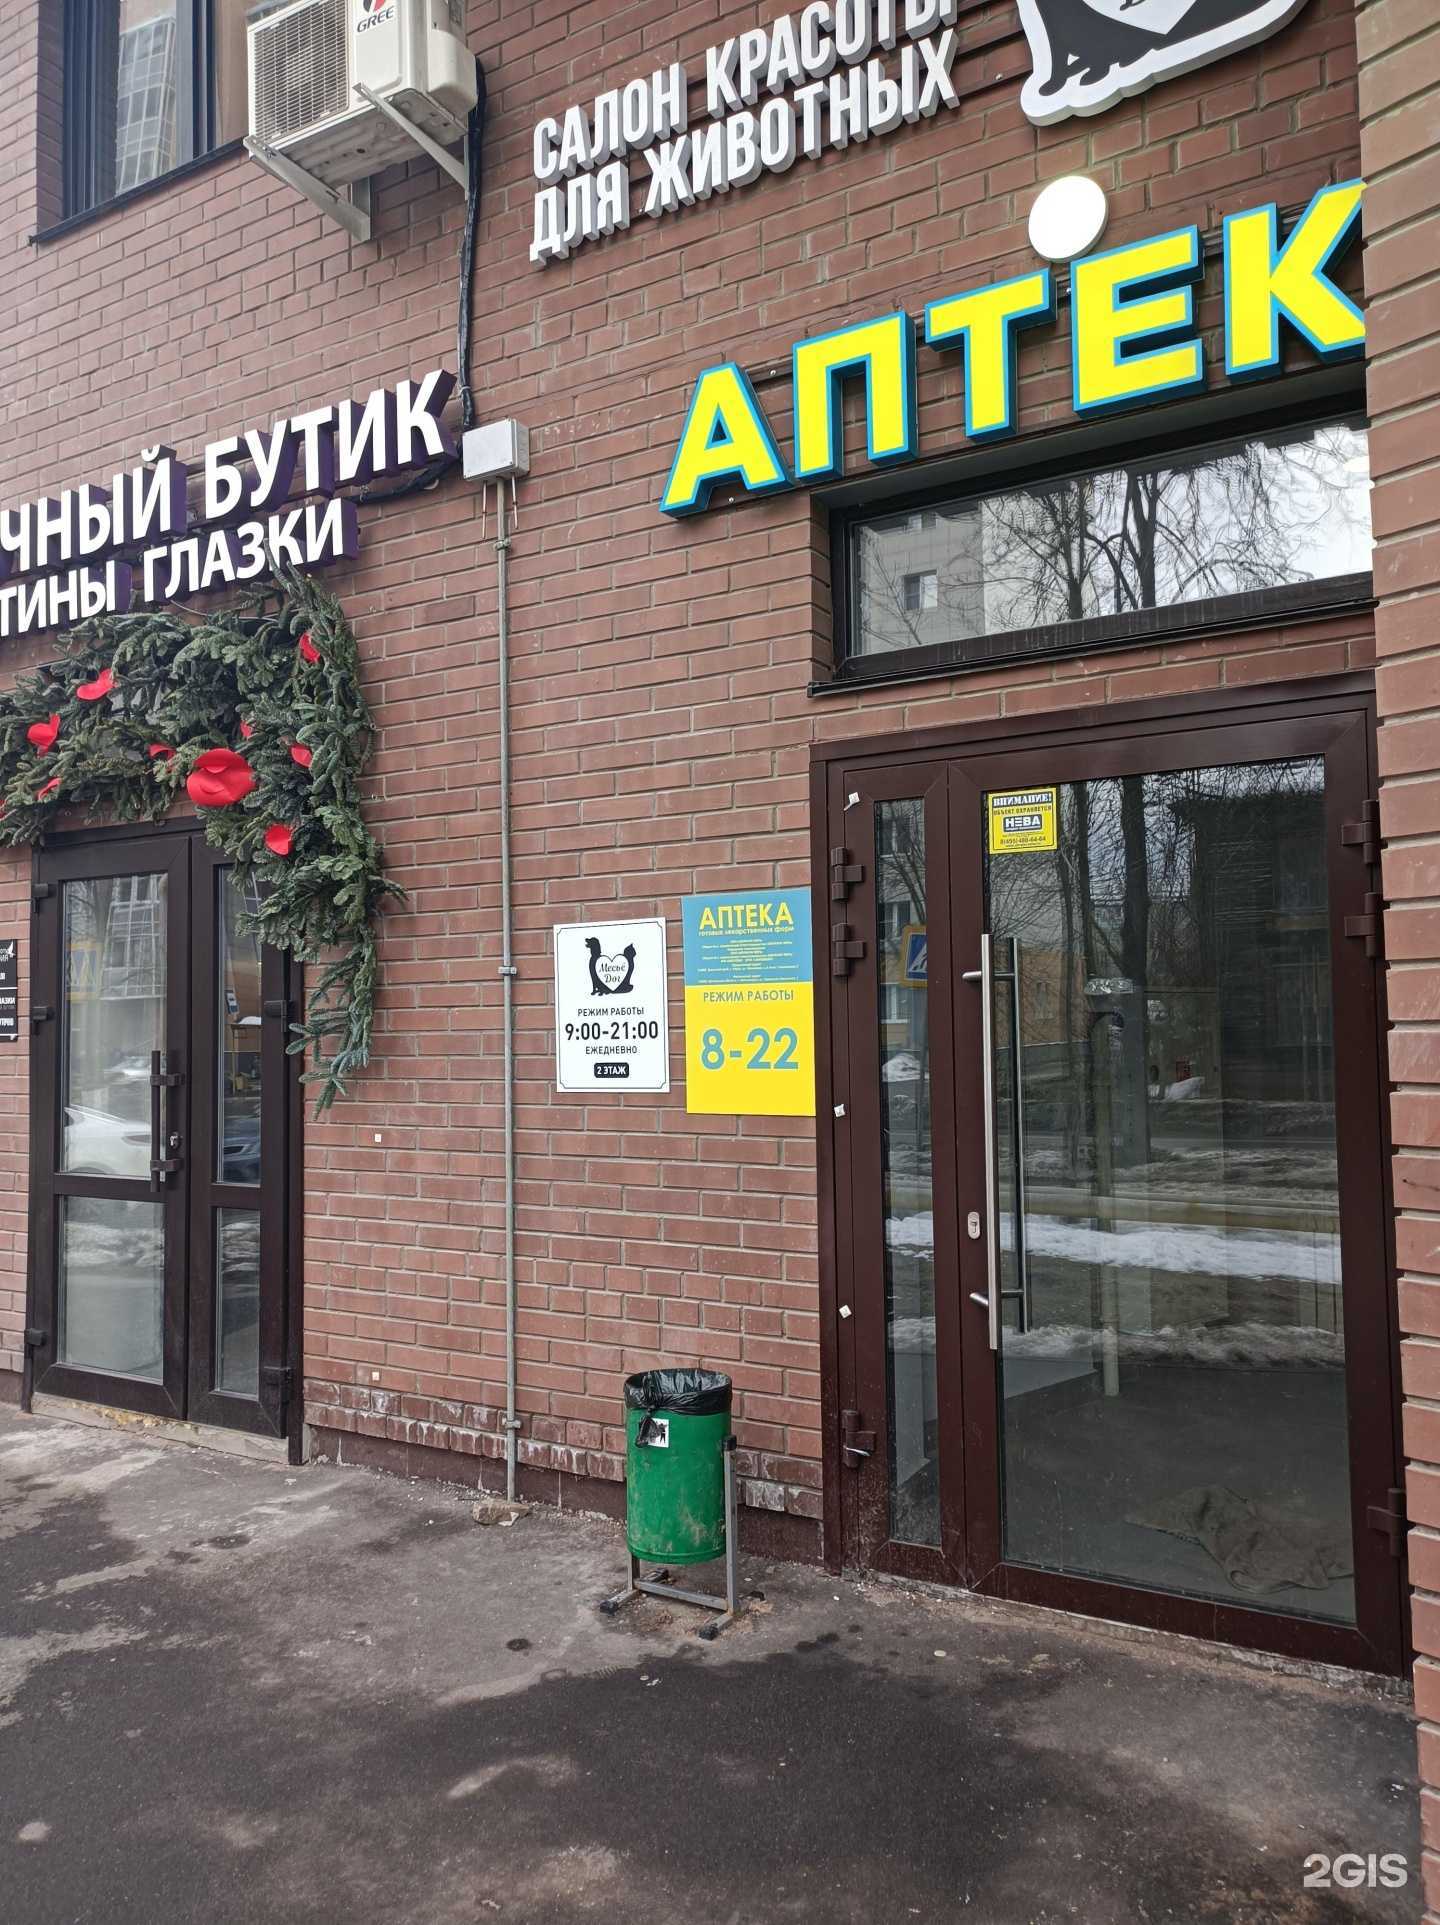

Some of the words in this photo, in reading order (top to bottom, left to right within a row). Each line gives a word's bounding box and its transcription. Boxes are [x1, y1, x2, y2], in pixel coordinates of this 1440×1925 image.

[357, 6, 395, 33] GREE
[533, 63, 686, 184] САЛОН
[530, 161, 629, 266] ДЛЯ
[643, 28, 958, 217] ЖИВОТНЫХ
[0, 445, 178, 573] ЧНЫЙ
[205, 369, 450, 520] БУТИК
[0, 560, 118, 638] ТИНЫ
[143, 498, 350, 602] ГЛАЗКИ
[993, 793, 1052, 806] ВНИМАНИЕ!
[699, 902, 794, 930] АПТЕКА
[703, 991, 744, 1002] РЕЖИМ
[747, 989, 794, 1001] РАБОТЫ
[577, 1008, 608, 1017] РЕЖИМ
[610, 1006, 645, 1016] РАБОТЫ
[565, 1020, 659, 1041] 9:00-21:00
[585, 1045, 638, 1056] ЕЖЕДНЕВНО
[701, 1027, 799, 1070] 8-22
[597, 1066, 602, 1075] 2
[603, 1065, 627, 1075] ЭТАЖ
